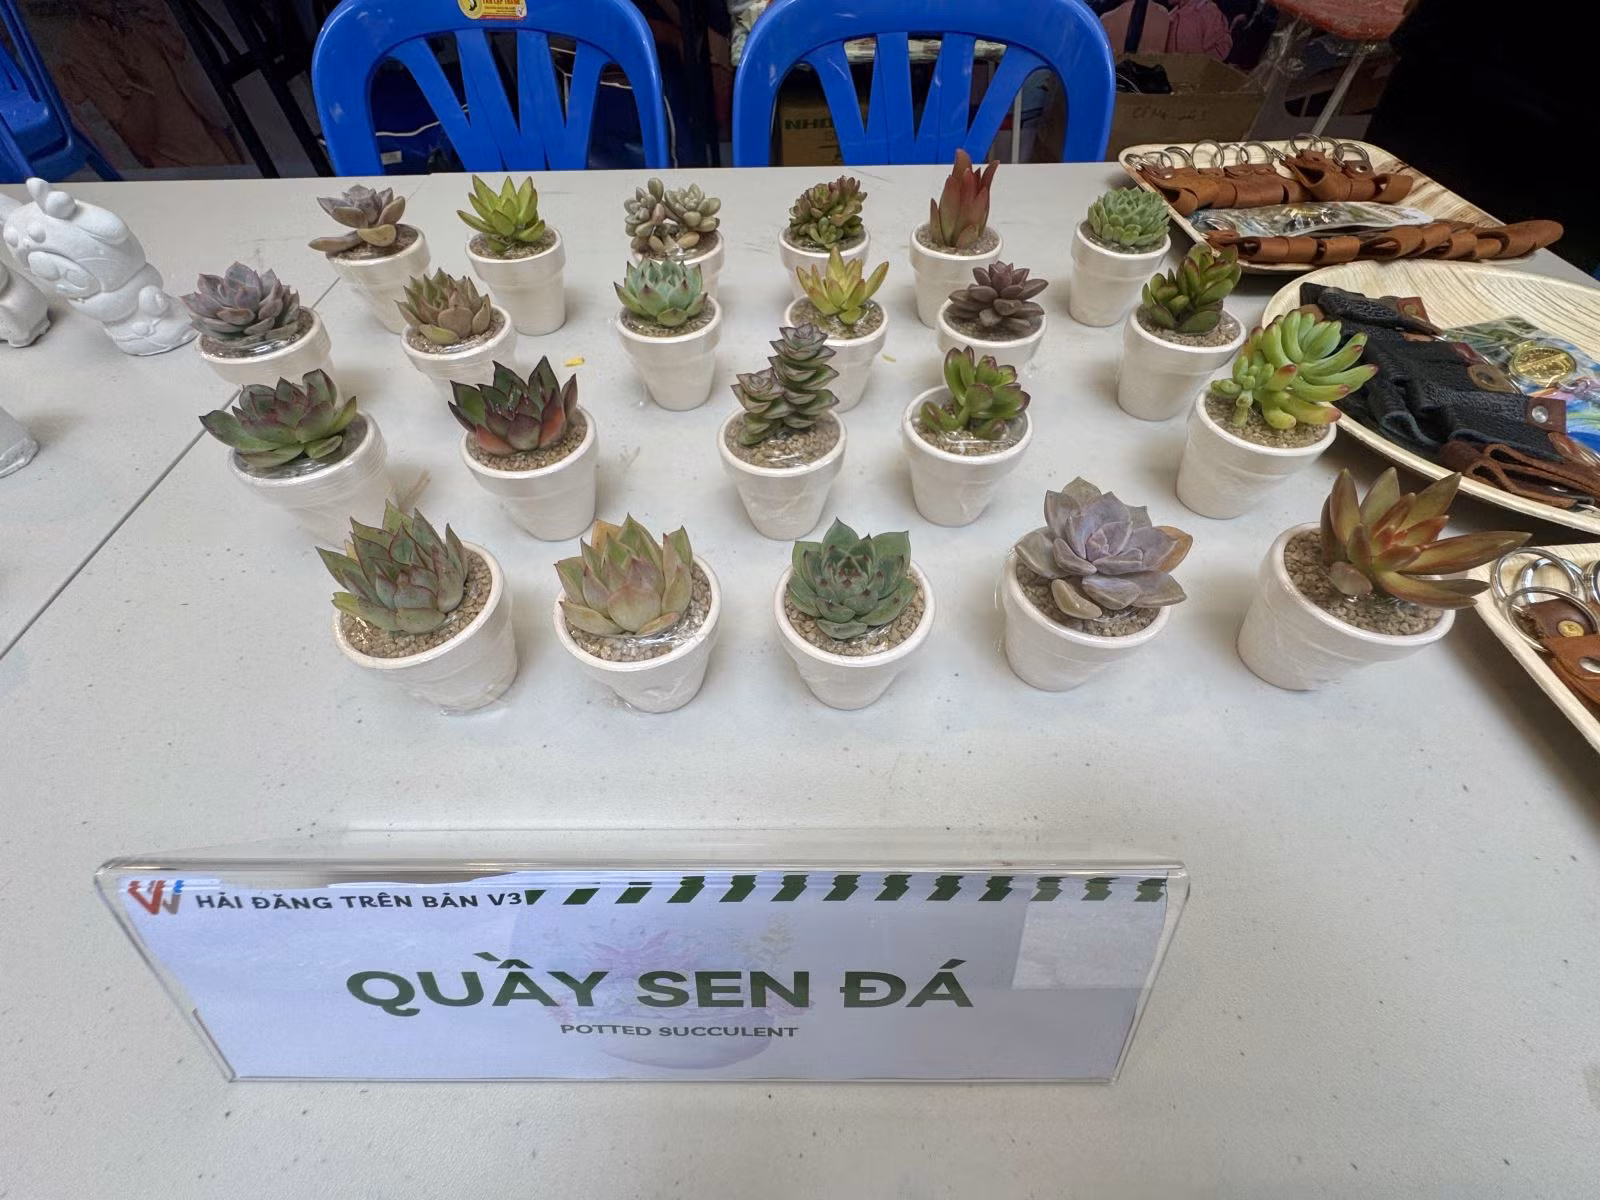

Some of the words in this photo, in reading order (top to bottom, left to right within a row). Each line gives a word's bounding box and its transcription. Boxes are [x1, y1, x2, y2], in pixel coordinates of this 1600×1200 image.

[195, 891, 242, 908] HẢI
[251, 894, 333, 910] ĐĂNG
[339, 892, 412, 908] TRÊN
[487, 892, 522, 906] V3
[346, 951, 609, 1017] QUẦY
[636, 970, 810, 1009] SEN
[839, 958, 975, 1009] ĐÁ
[560, 1024, 651, 1036] POTTED
[658, 1026, 800, 1038] SUCCULENT
